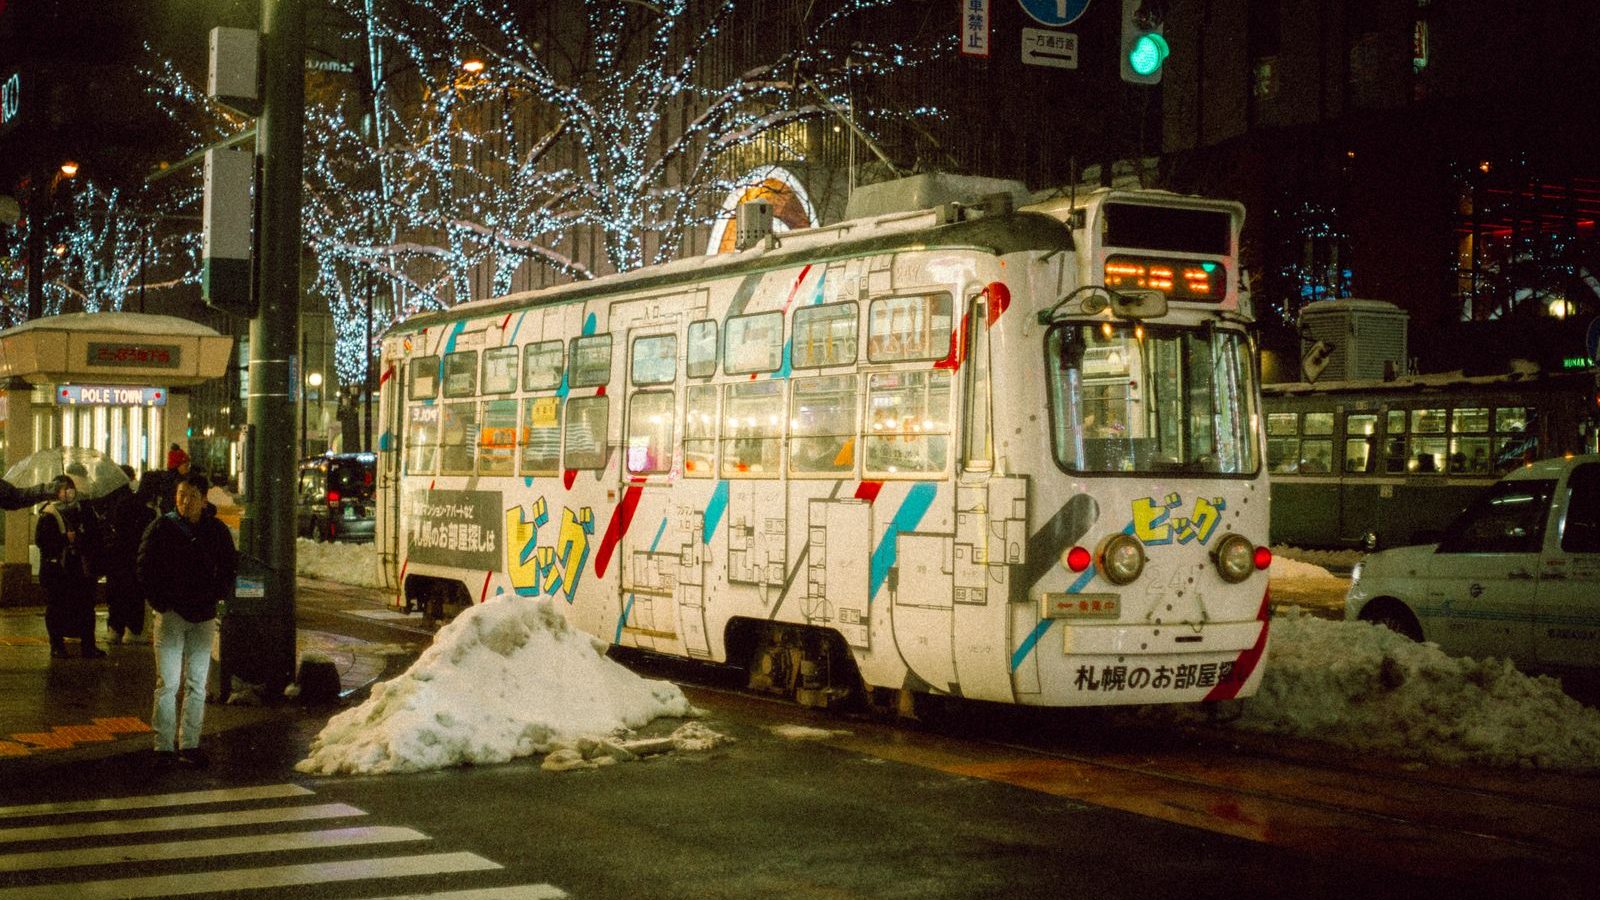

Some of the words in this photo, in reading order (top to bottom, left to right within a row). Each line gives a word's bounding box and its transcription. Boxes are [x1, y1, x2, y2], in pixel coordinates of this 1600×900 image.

[80, 389, 111, 403] POLE
[113, 389, 143, 404] TOWN
[1132, 491, 1227, 546] ビッグ
[506, 496, 595, 604] ビッグ
